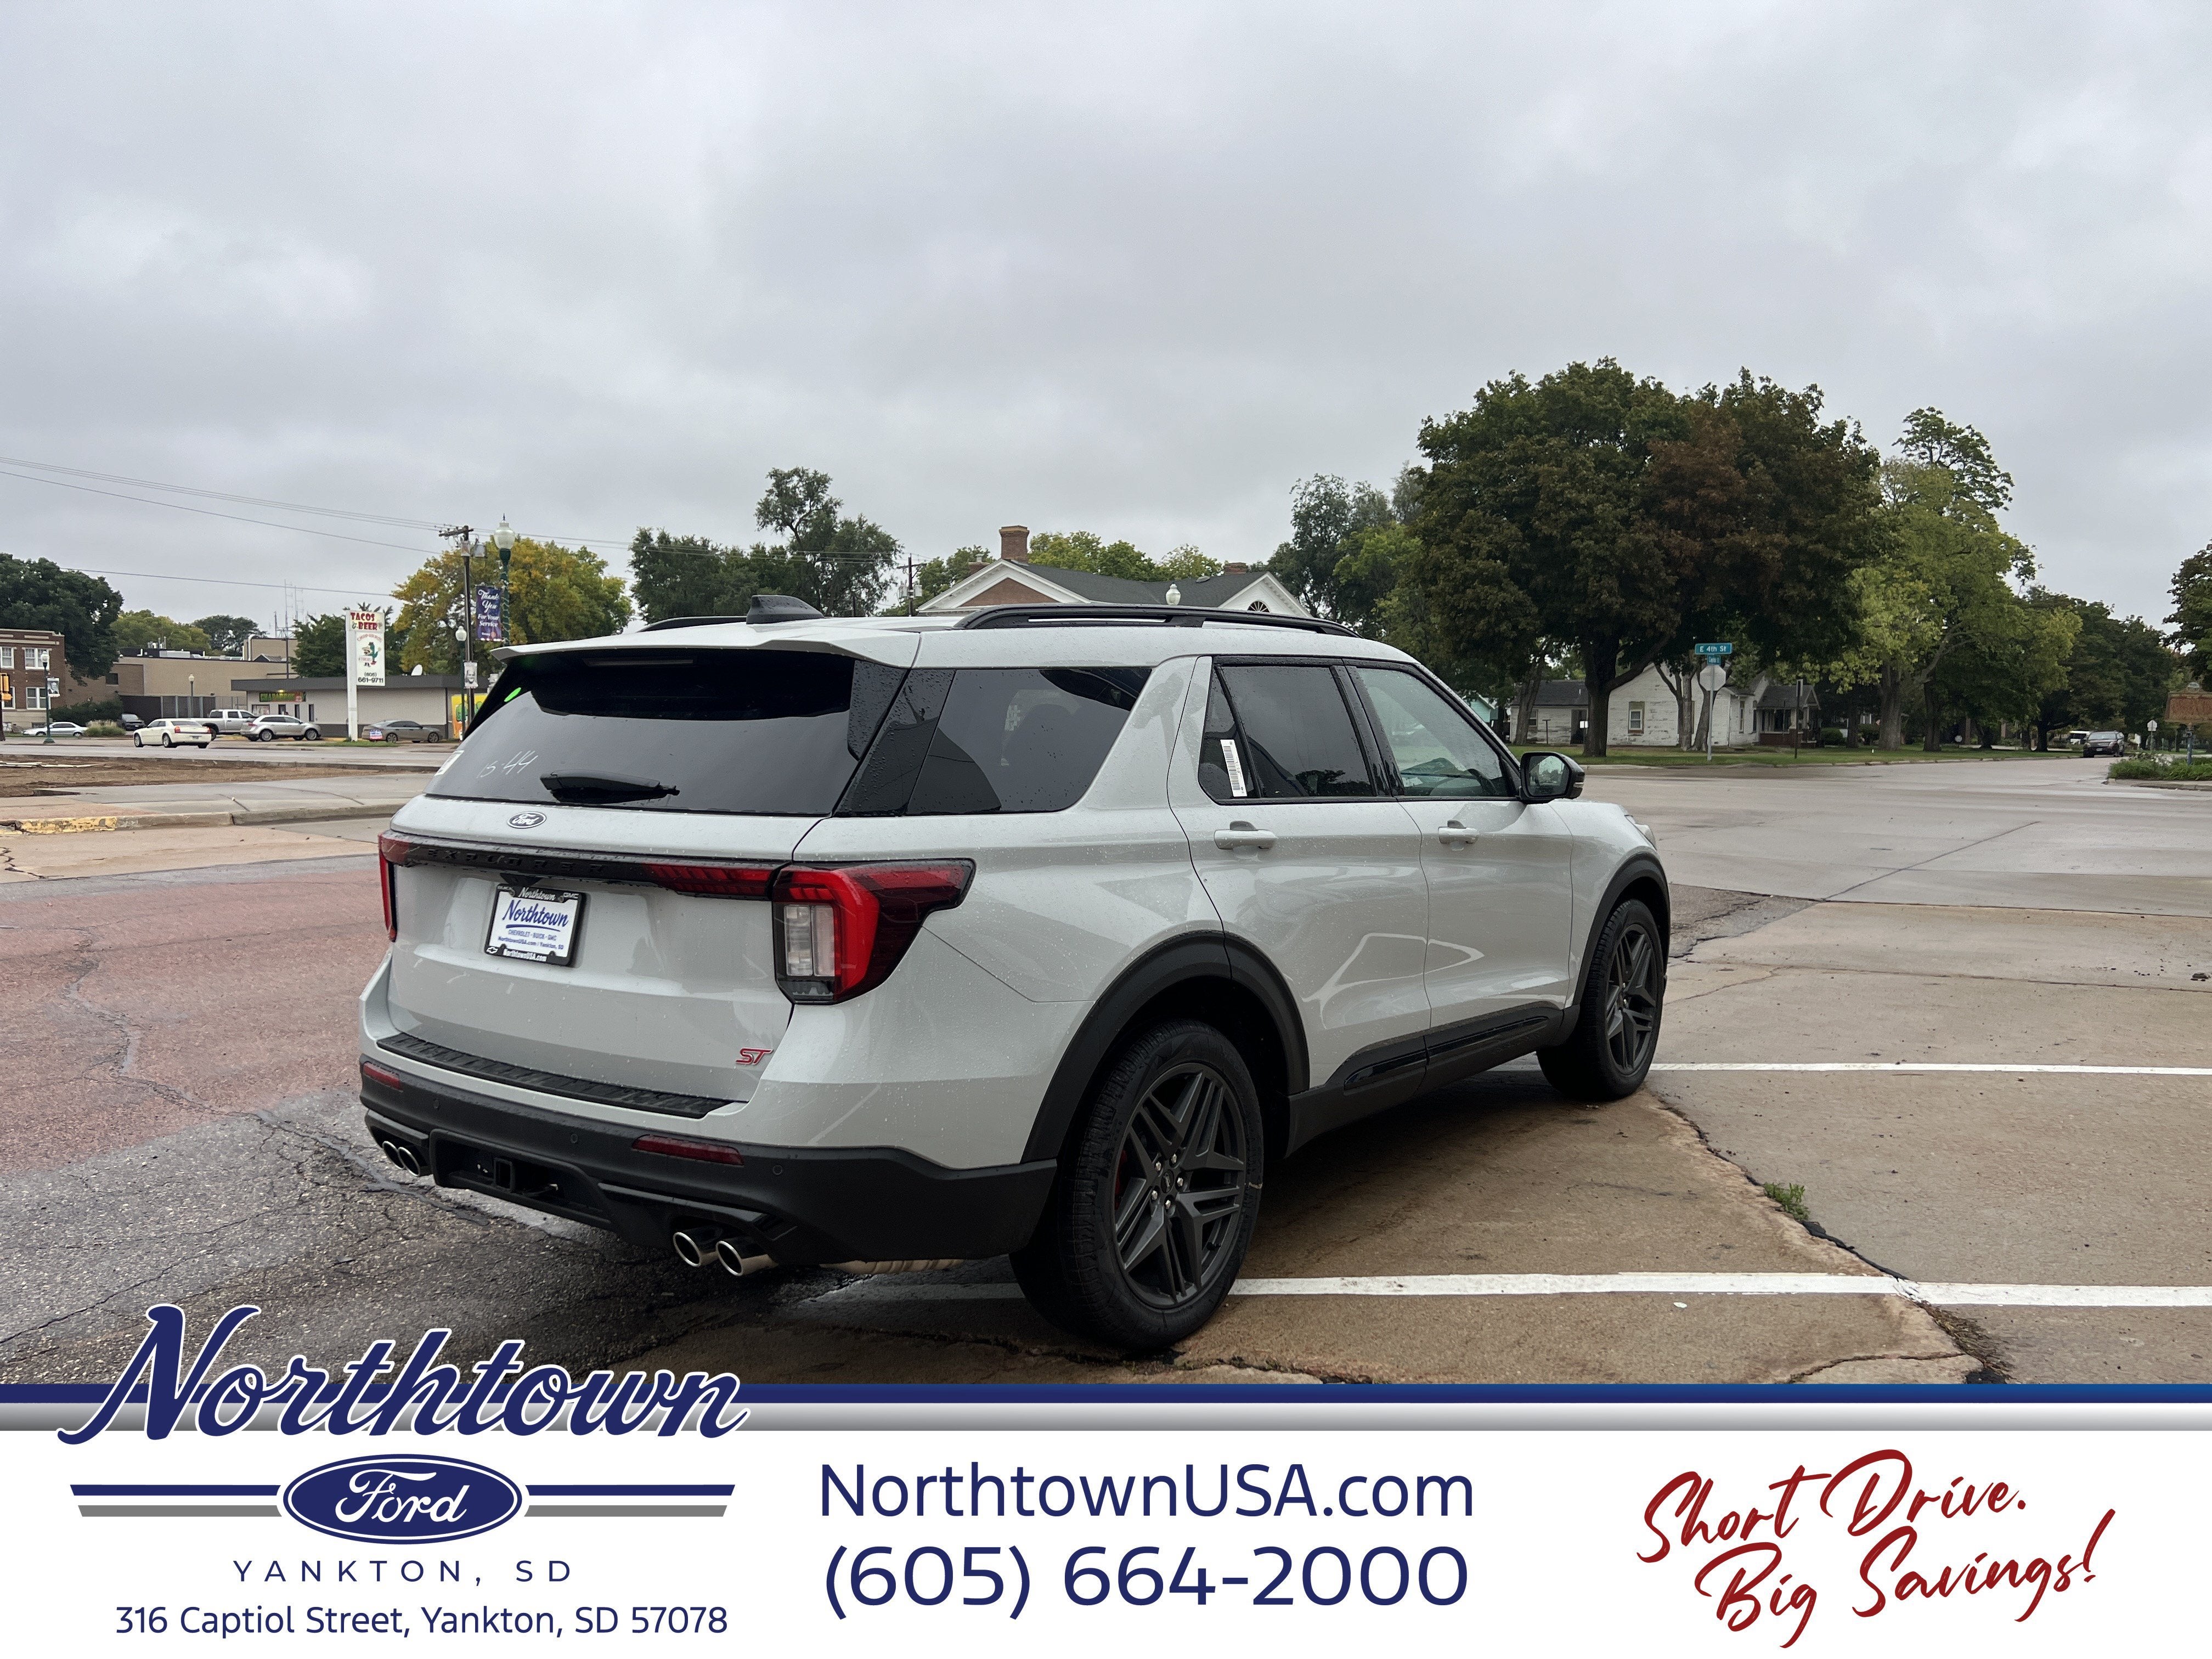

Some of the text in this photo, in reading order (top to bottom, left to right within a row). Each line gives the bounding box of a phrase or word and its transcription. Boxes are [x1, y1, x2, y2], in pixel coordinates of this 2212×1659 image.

[482, 600, 498, 613] You
[351, 612, 375, 621] TACOS
[358, 621, 377, 630] BEER
[511, 812, 540, 825] Ford
[518, 887, 556, 901] Northtown
[502, 900, 569, 927] Northtown
[736, 1047, 774, 1065] ST
